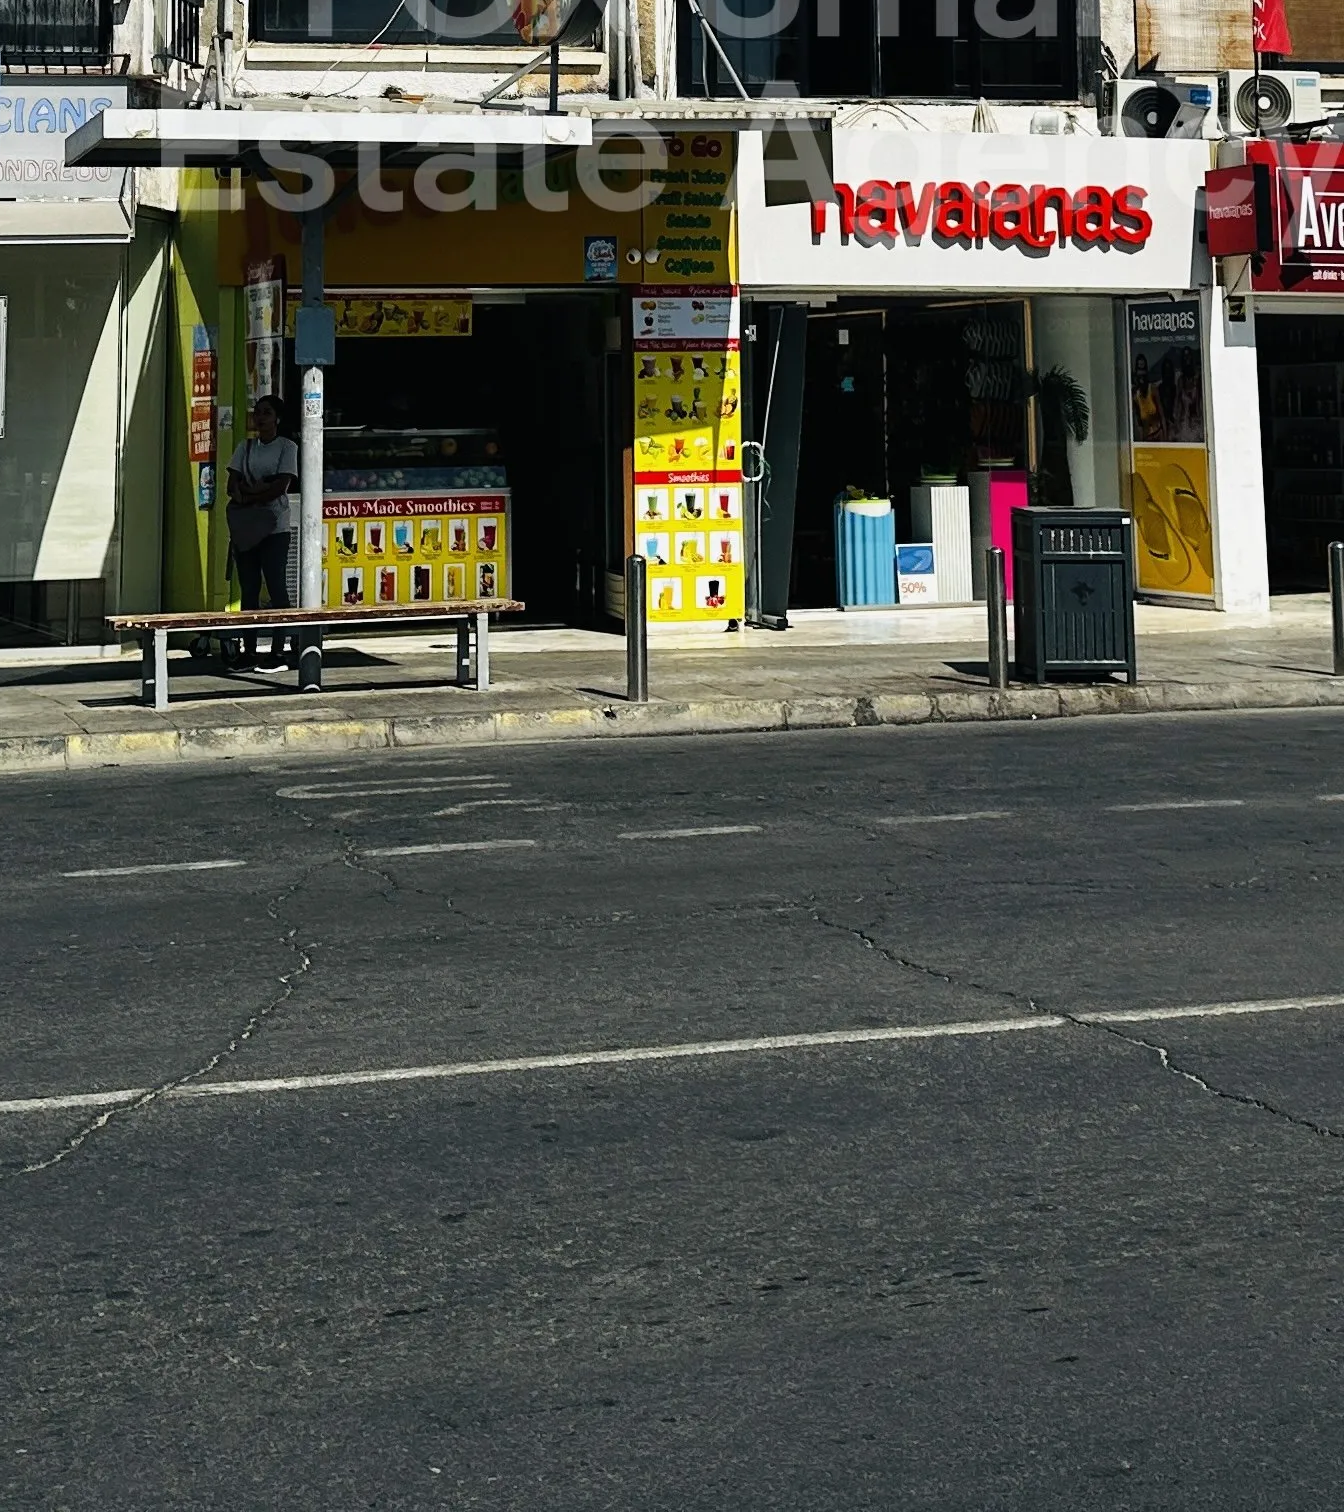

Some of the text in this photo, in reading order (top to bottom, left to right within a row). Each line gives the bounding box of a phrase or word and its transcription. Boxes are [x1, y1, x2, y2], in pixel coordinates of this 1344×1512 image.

[691, 136, 722, 158] Go
[1209, 204, 1253, 219] havaianas
[1132, 310, 1195, 332] havaianas
[668, 473, 710, 483] Smoothies
[322, 502, 359, 517] reshly
[362, 500, 403, 515] Made
[406, 499, 476, 514] Smoothies
[901, 582, 927, 594] 50%
